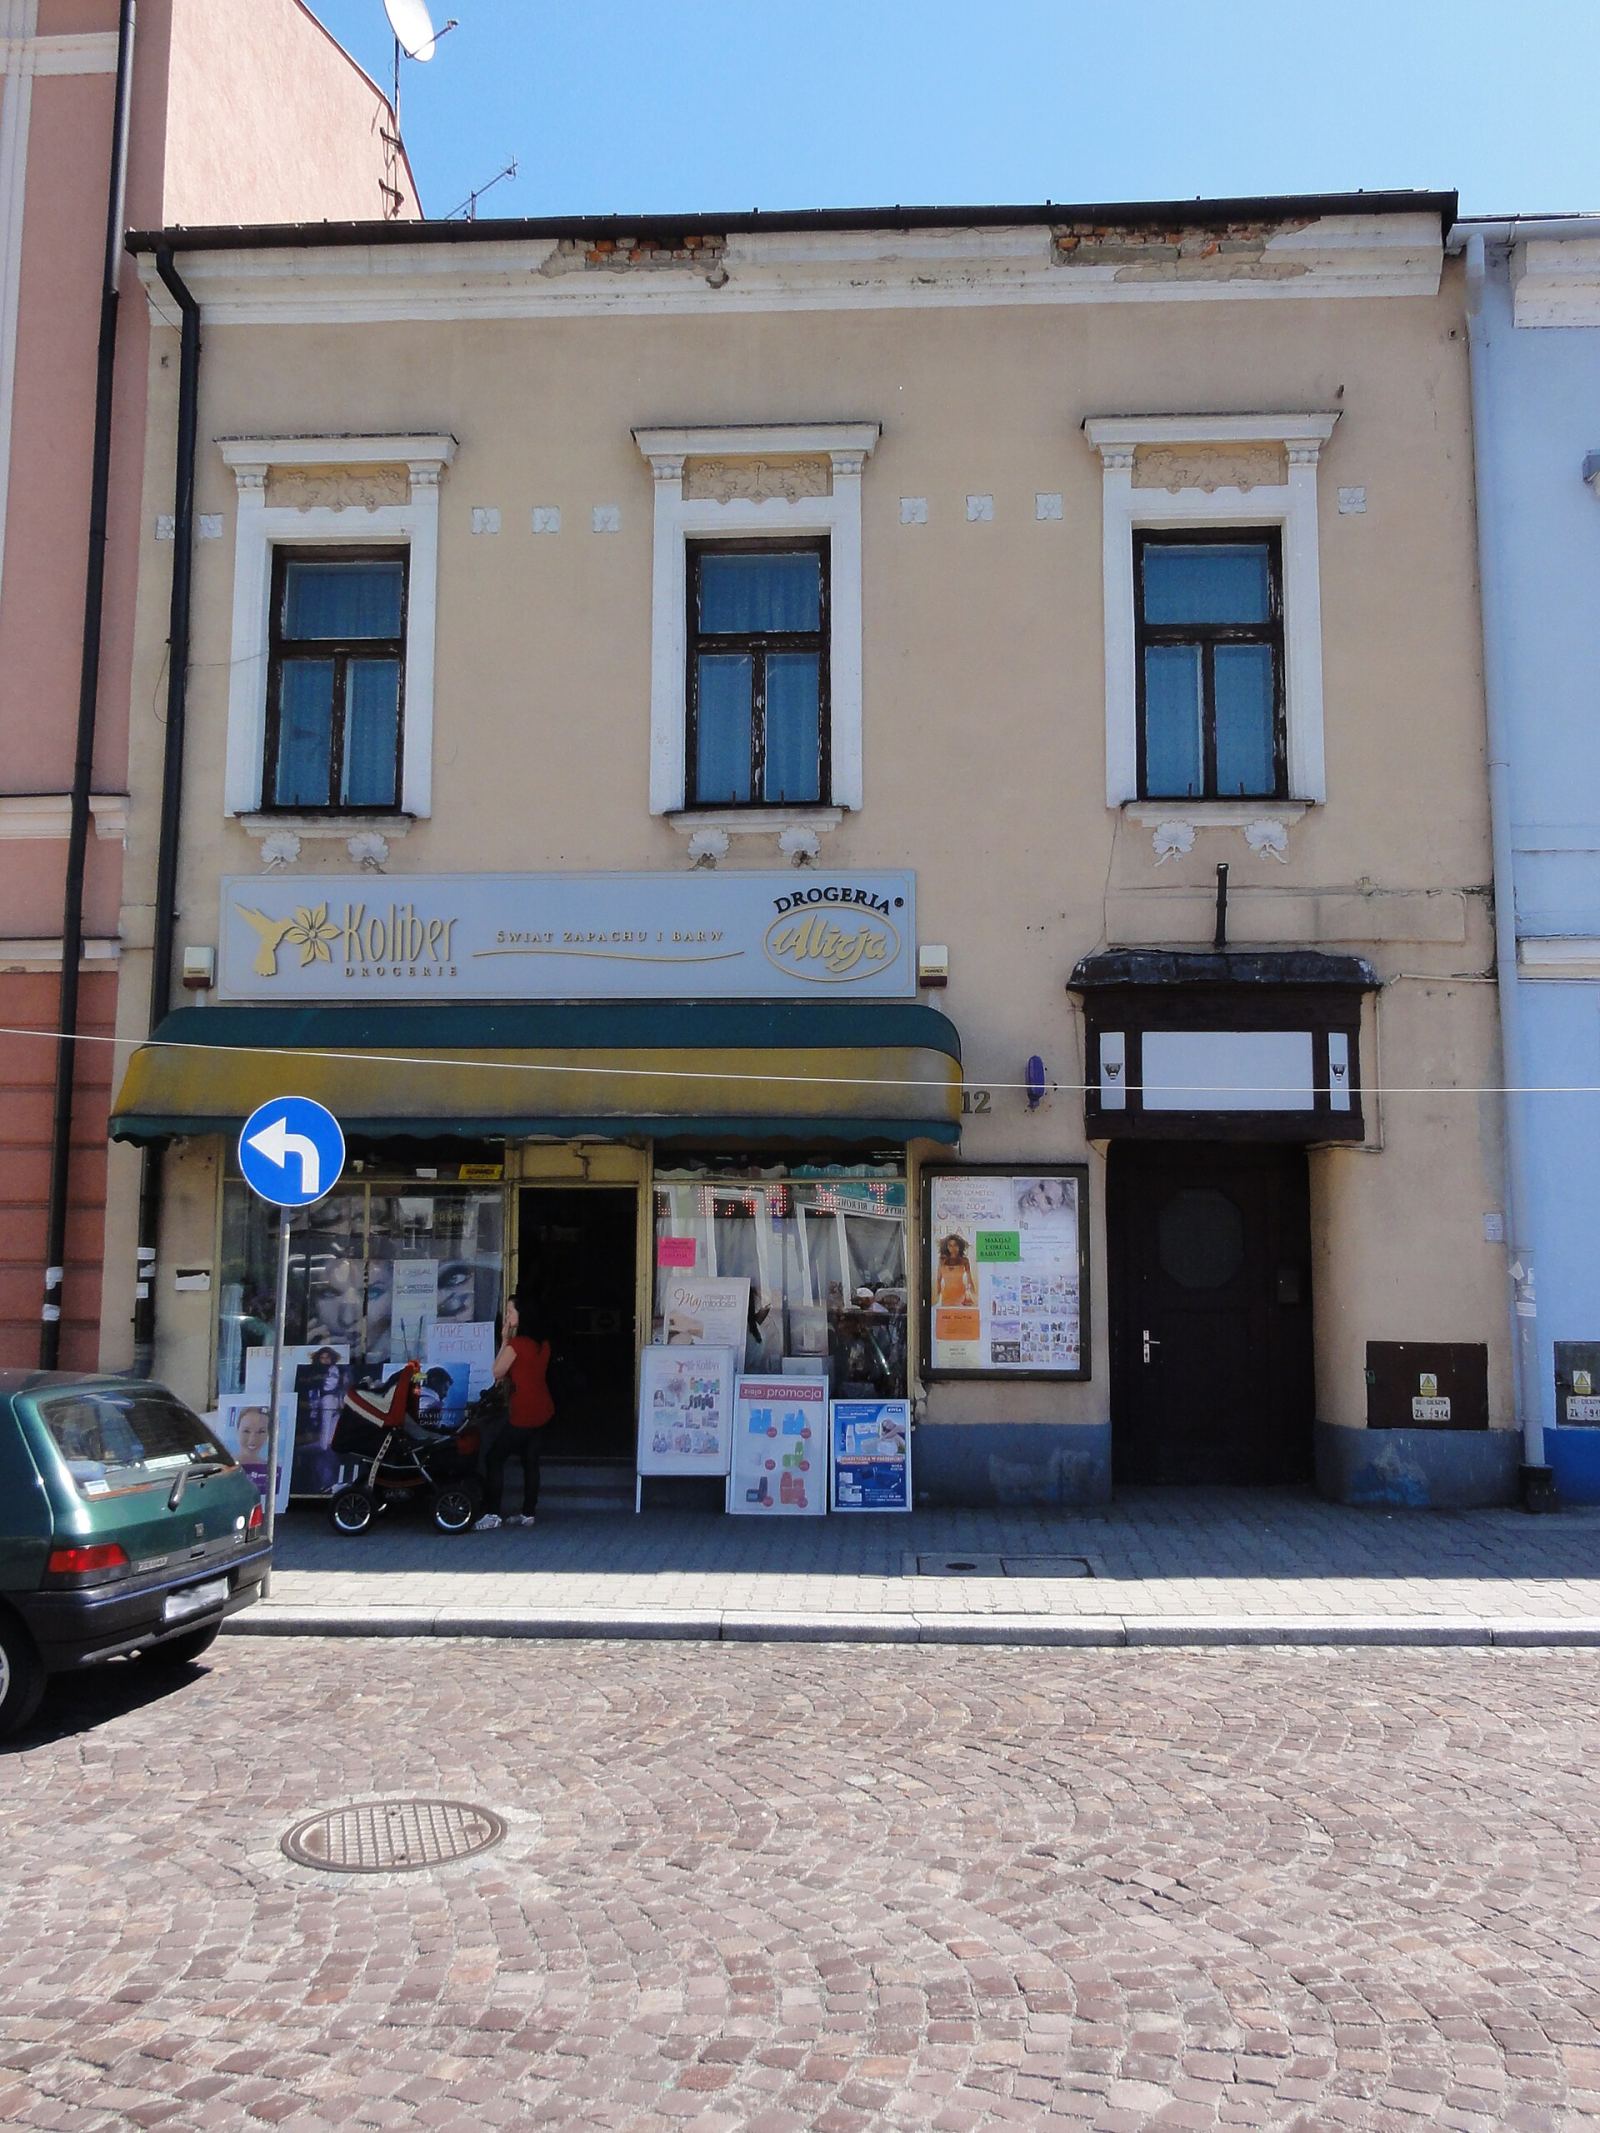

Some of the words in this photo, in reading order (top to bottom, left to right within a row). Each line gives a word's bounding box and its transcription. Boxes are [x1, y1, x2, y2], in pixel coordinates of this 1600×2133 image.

[772, 887, 890, 915] DROGERIA
[343, 903, 458, 962] Koliber
[563, 930, 648, 943] ZAPACHU
[656, 931, 664, 943] I
[672, 930, 724, 943] BARW
[772, 914, 887, 974] Alicja
[344, 966, 458, 977] DROGERIE
[961, 1090, 992, 1114] 12
[767, 1387, 822, 1400] promocja
